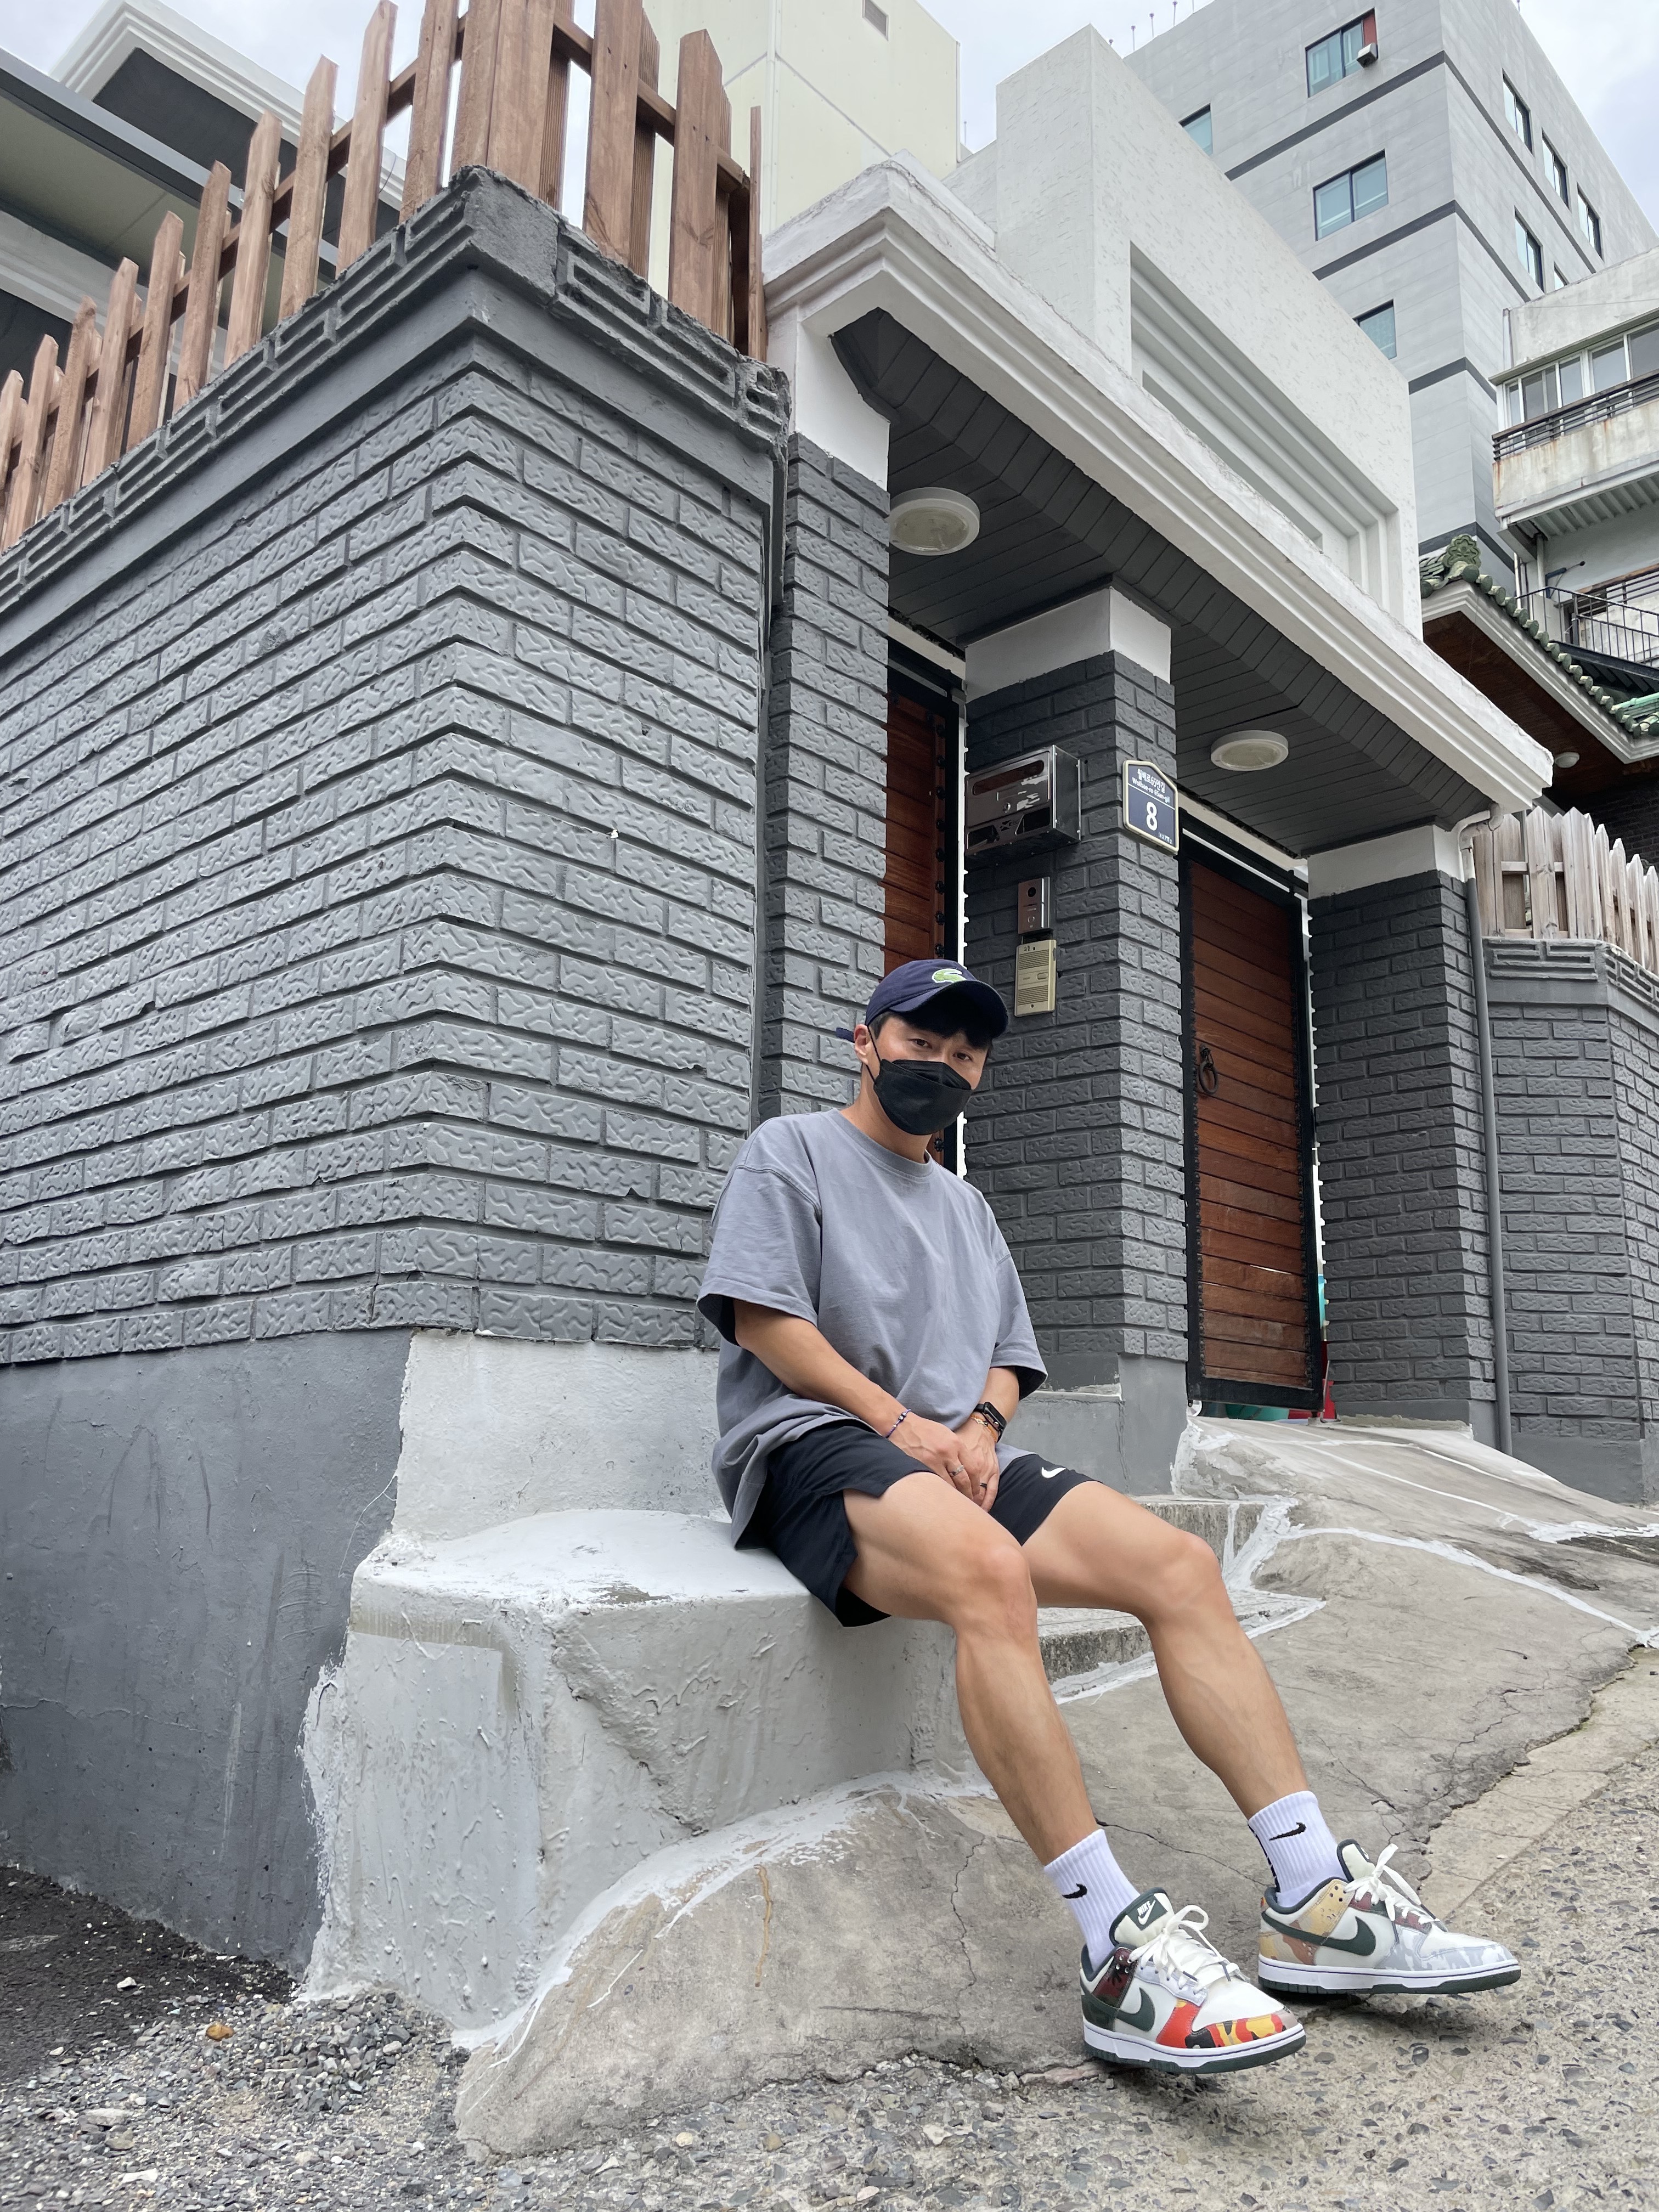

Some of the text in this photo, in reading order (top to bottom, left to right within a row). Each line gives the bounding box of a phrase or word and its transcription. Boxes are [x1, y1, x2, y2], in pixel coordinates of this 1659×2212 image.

[1132, 777, 1170, 803] Wolbae-ro 65an-gil
[1146, 802, 1158, 831] 8
[1137, 1900, 1152, 1916] NIKE
